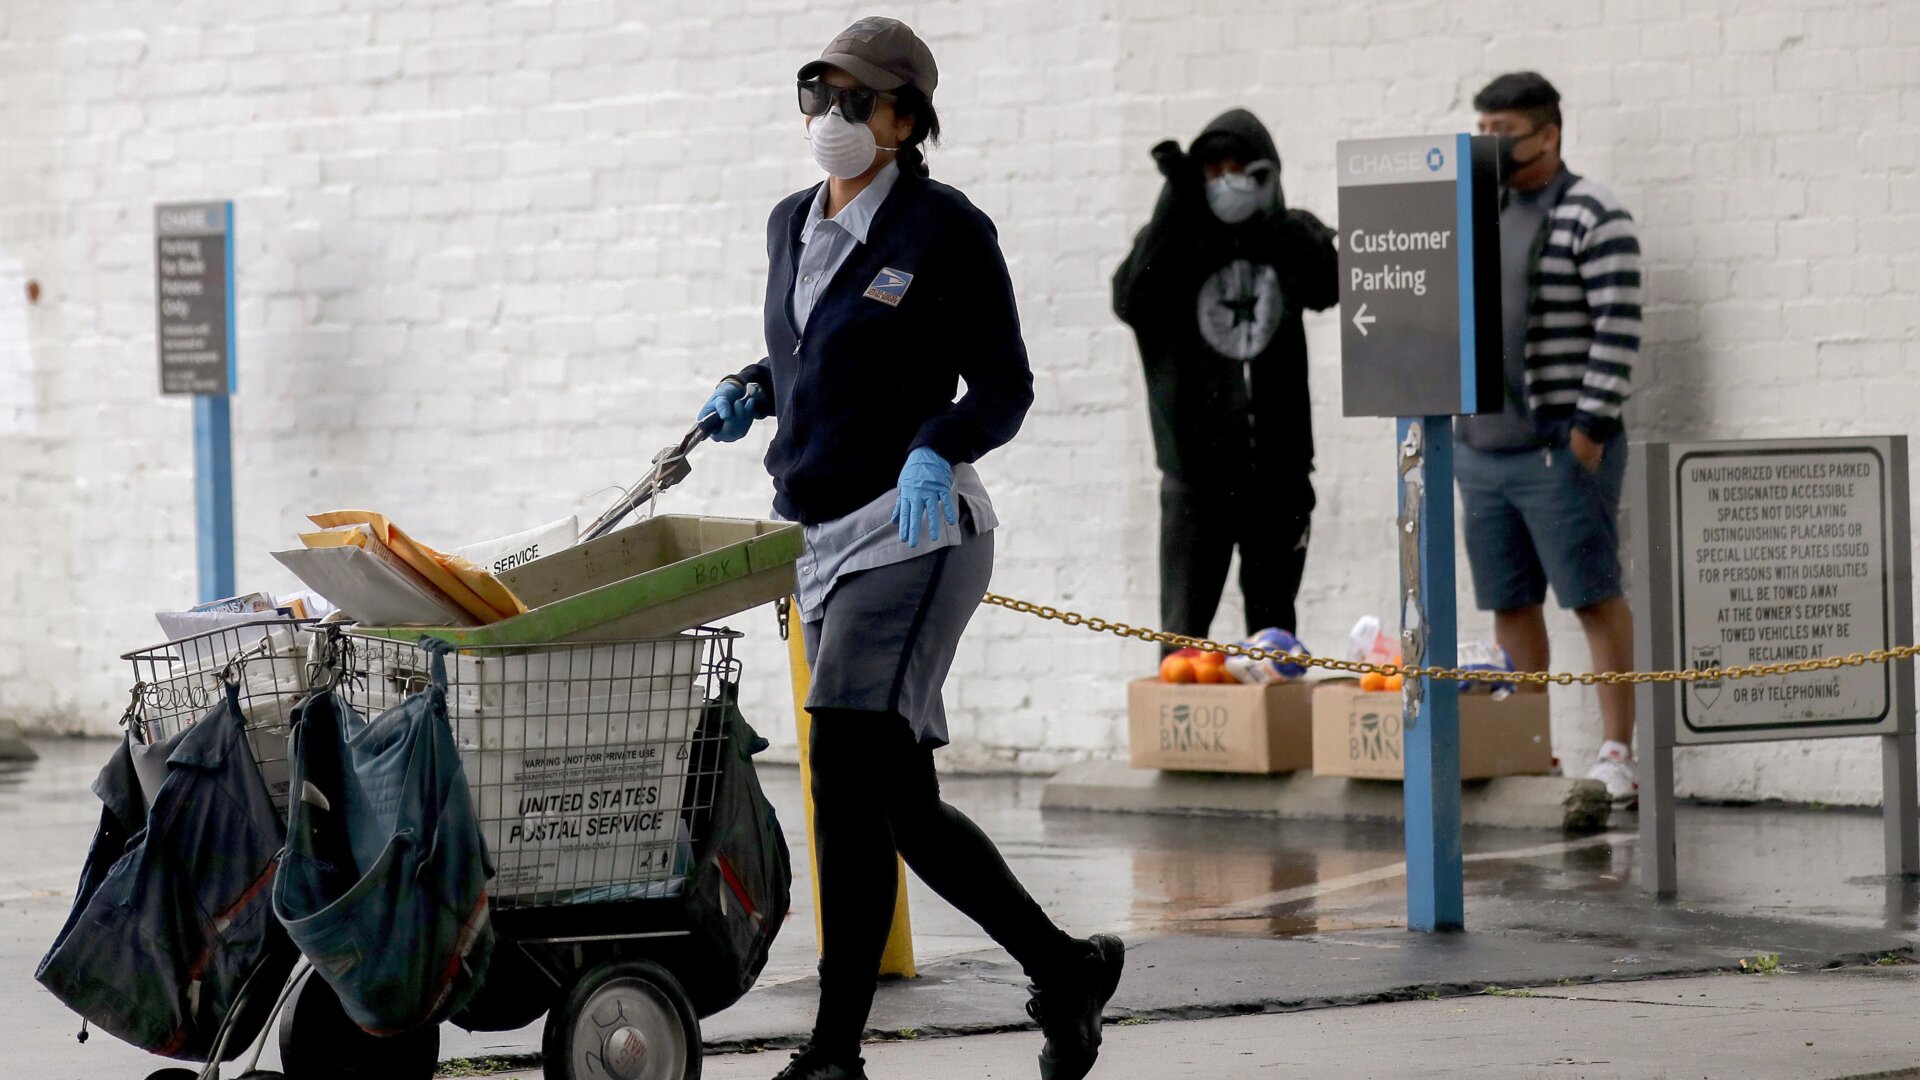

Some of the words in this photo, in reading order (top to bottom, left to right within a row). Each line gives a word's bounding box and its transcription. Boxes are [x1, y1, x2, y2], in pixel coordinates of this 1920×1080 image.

[1350, 153, 1421, 175] CHASE
[1350, 229, 1450, 254] Customer
[1351, 264, 1426, 296] Parking
[1691, 465, 1772, 483] UNAUTHORIZED
[1775, 464, 1826, 480] VEHICLES
[1829, 462, 1870, 478] PARKED
[1708, 487, 1719, 502] IN
[1723, 485, 1788, 502] DESIGNATED
[1791, 483, 1854, 499] ACCESSIBLE
[1717, 506, 1758, 522] SPACES
[1761, 505, 1782, 520] NOT
[1785, 503, 1847, 520] DISPLAYING
[1703, 526, 1787, 543] DISTINGUISHING
[1790, 523, 1845, 540] PLACARDS
[1848, 523, 1862, 537] OR
[494, 544, 539, 574] SERVICE
[1696, 548, 1741, 564] SPECIAL
[1743, 545, 1788, 561] LICENSE
[1790, 544, 1829, 560] PLATES
[1832, 542, 1869, 558] ISSUED
[1699, 568, 1719, 583] FOR
[1723, 566, 1772, 583] PERSONS
[1774, 565, 1800, 581] WITH
[1802, 562, 1868, 580] DISABILITIES
[1729, 587, 1754, 602] WILL
[1757, 586, 1768, 601] BE
[1774, 585, 1807, 600] TOWED
[1810, 584, 1838, 599] AWAY
[1717, 608, 1731, 623] AT
[1733, 607, 1752, 623] THE
[1755, 605, 1801, 621] OWNER'S
[1805, 603, 1851, 619] EXPENSE
[1720, 627, 1754, 643] TOWED
[1758, 625, 1809, 642] VEHICLES
[1812, 624, 1833, 639] MAY
[1837, 623, 1850, 638] BE
[1749, 645, 1808, 662] RECLAIMED
[1811, 644, 1824, 659] AT
[1733, 687, 1748, 702] OR
[1751, 687, 1764, 702] BY
[1768, 683, 1840, 701] TELEPHONING
[1348, 712, 1401, 738] FOO
[567, 755, 584, 766] NOT
[586, 753, 602, 765] FOR
[639, 748, 656, 760] USE
[1348, 737, 1401, 761] BAN
[518, 793, 583, 816] UNITED
[588, 786, 658, 809] STATES
[509, 820, 579, 844] POSTAL
[586, 811, 663, 836] SERVICE
